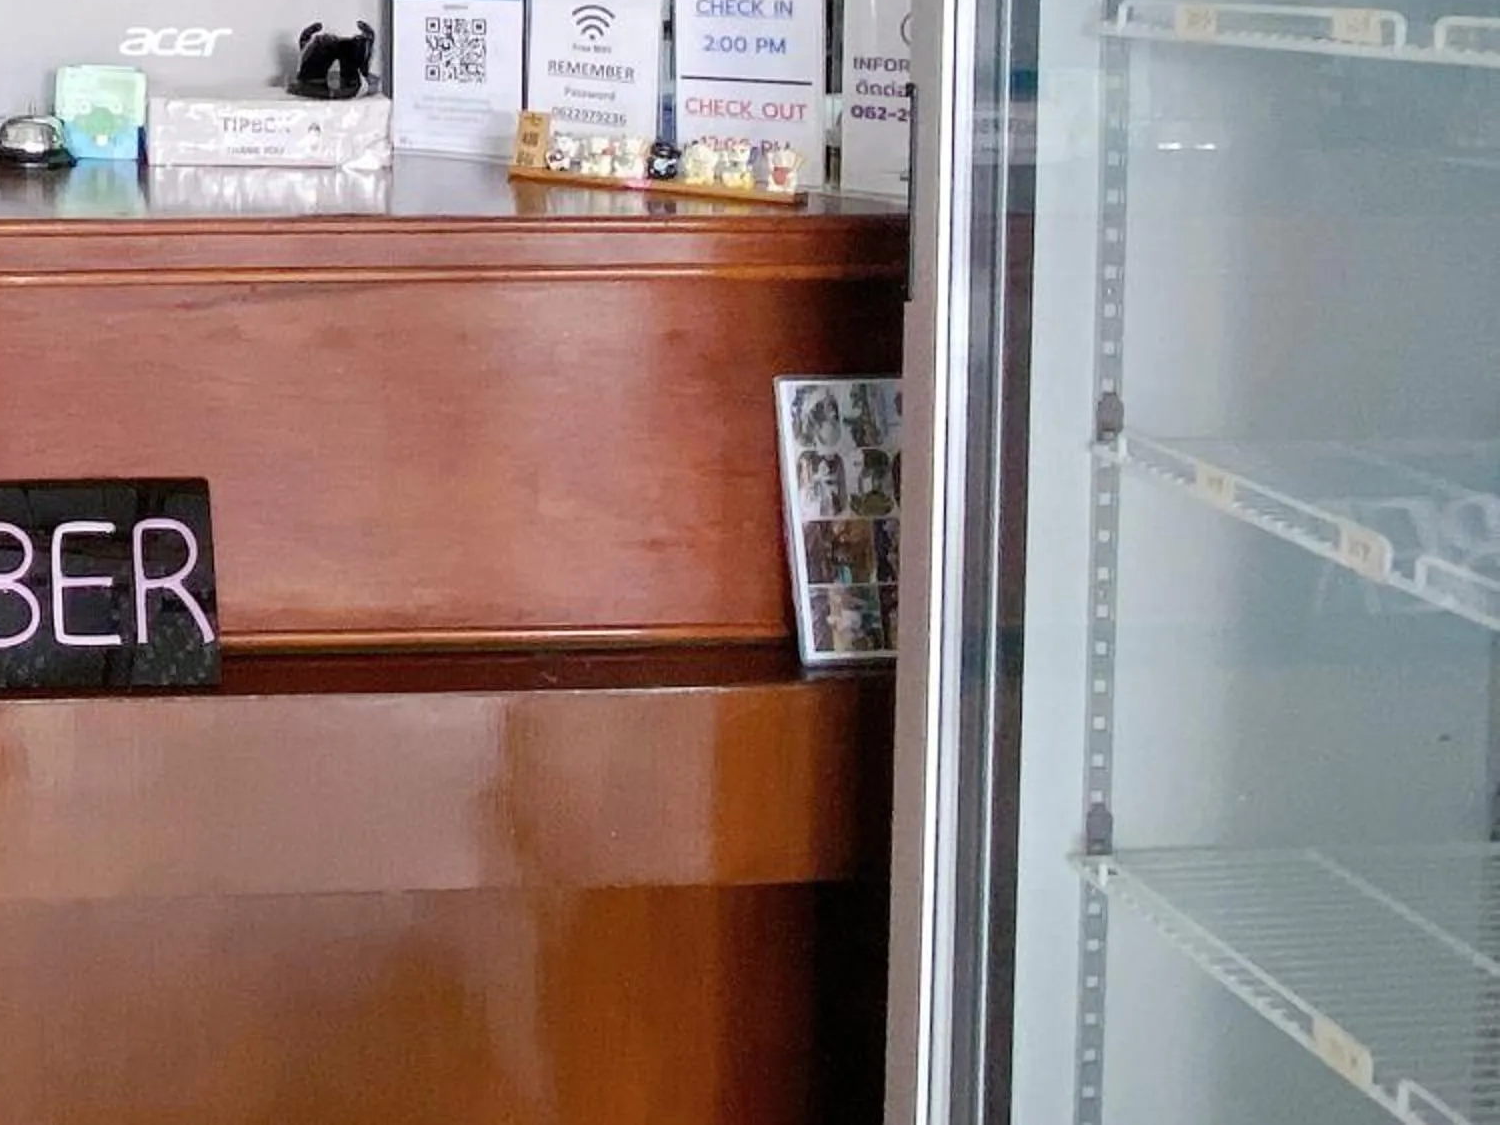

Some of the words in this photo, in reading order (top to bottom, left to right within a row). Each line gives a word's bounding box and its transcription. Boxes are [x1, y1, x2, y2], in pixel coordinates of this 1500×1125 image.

[774, 0, 794, 18] IN
[118, 26, 233, 58] acer
[702, 34, 747, 53] 2:00
[755, 36, 787, 55] PM
[547, 59, 635, 80] REMEMBER
[564, 86, 616, 101] Password
[685, 97, 752, 119] CHECK
[762, 101, 808, 121] OUT
[850, 105, 911, 122] 062-2
